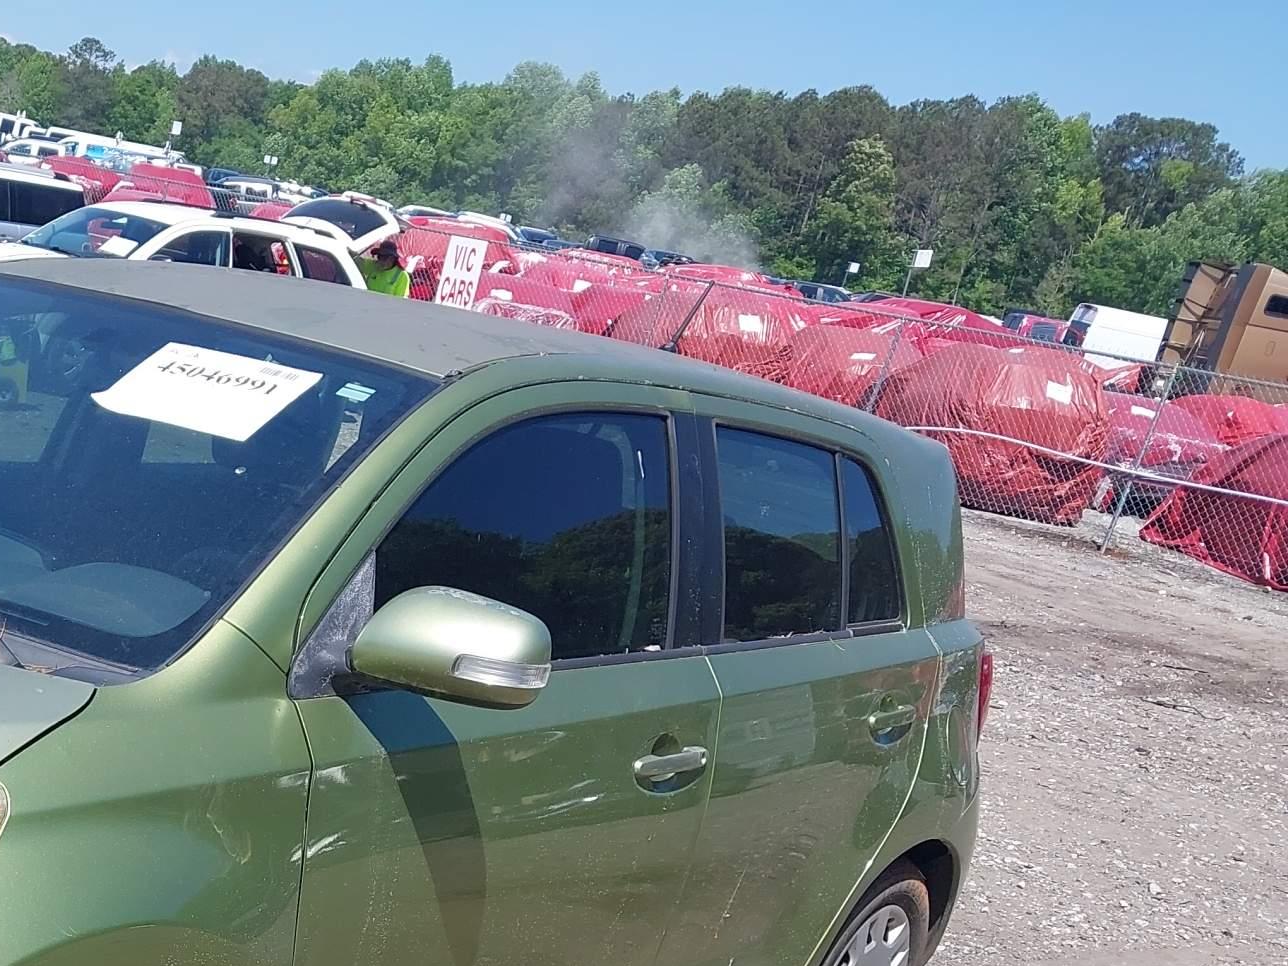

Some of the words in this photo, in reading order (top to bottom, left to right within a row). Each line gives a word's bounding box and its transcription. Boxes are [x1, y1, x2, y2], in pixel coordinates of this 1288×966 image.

[453, 245, 477, 273] VIC
[440, 276, 474, 307] CARS
[157, 360, 279, 396] 45046991
